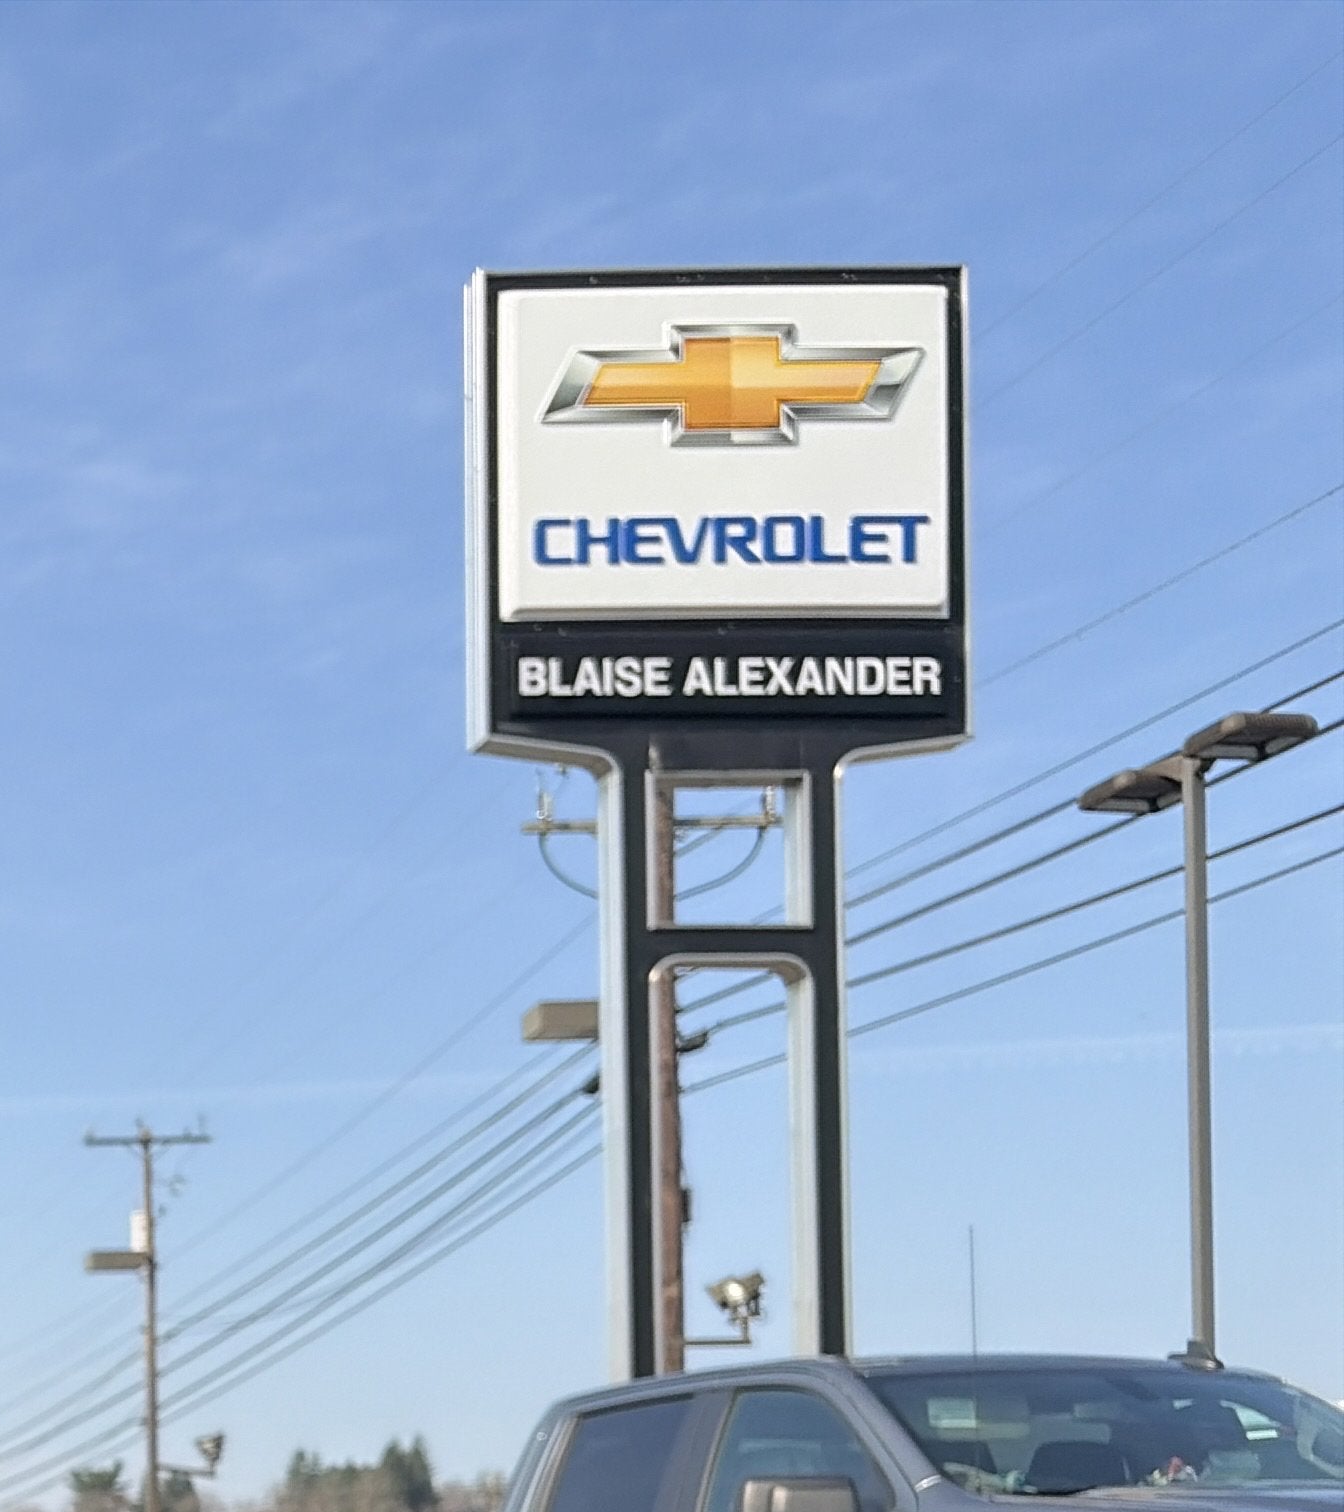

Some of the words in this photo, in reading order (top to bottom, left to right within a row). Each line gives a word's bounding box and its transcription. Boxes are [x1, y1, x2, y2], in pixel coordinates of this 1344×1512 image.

[533, 514, 930, 565] CHEVROLET
[518, 656, 673, 698] BLAISE
[682, 656, 942, 697] ALEXANDER
